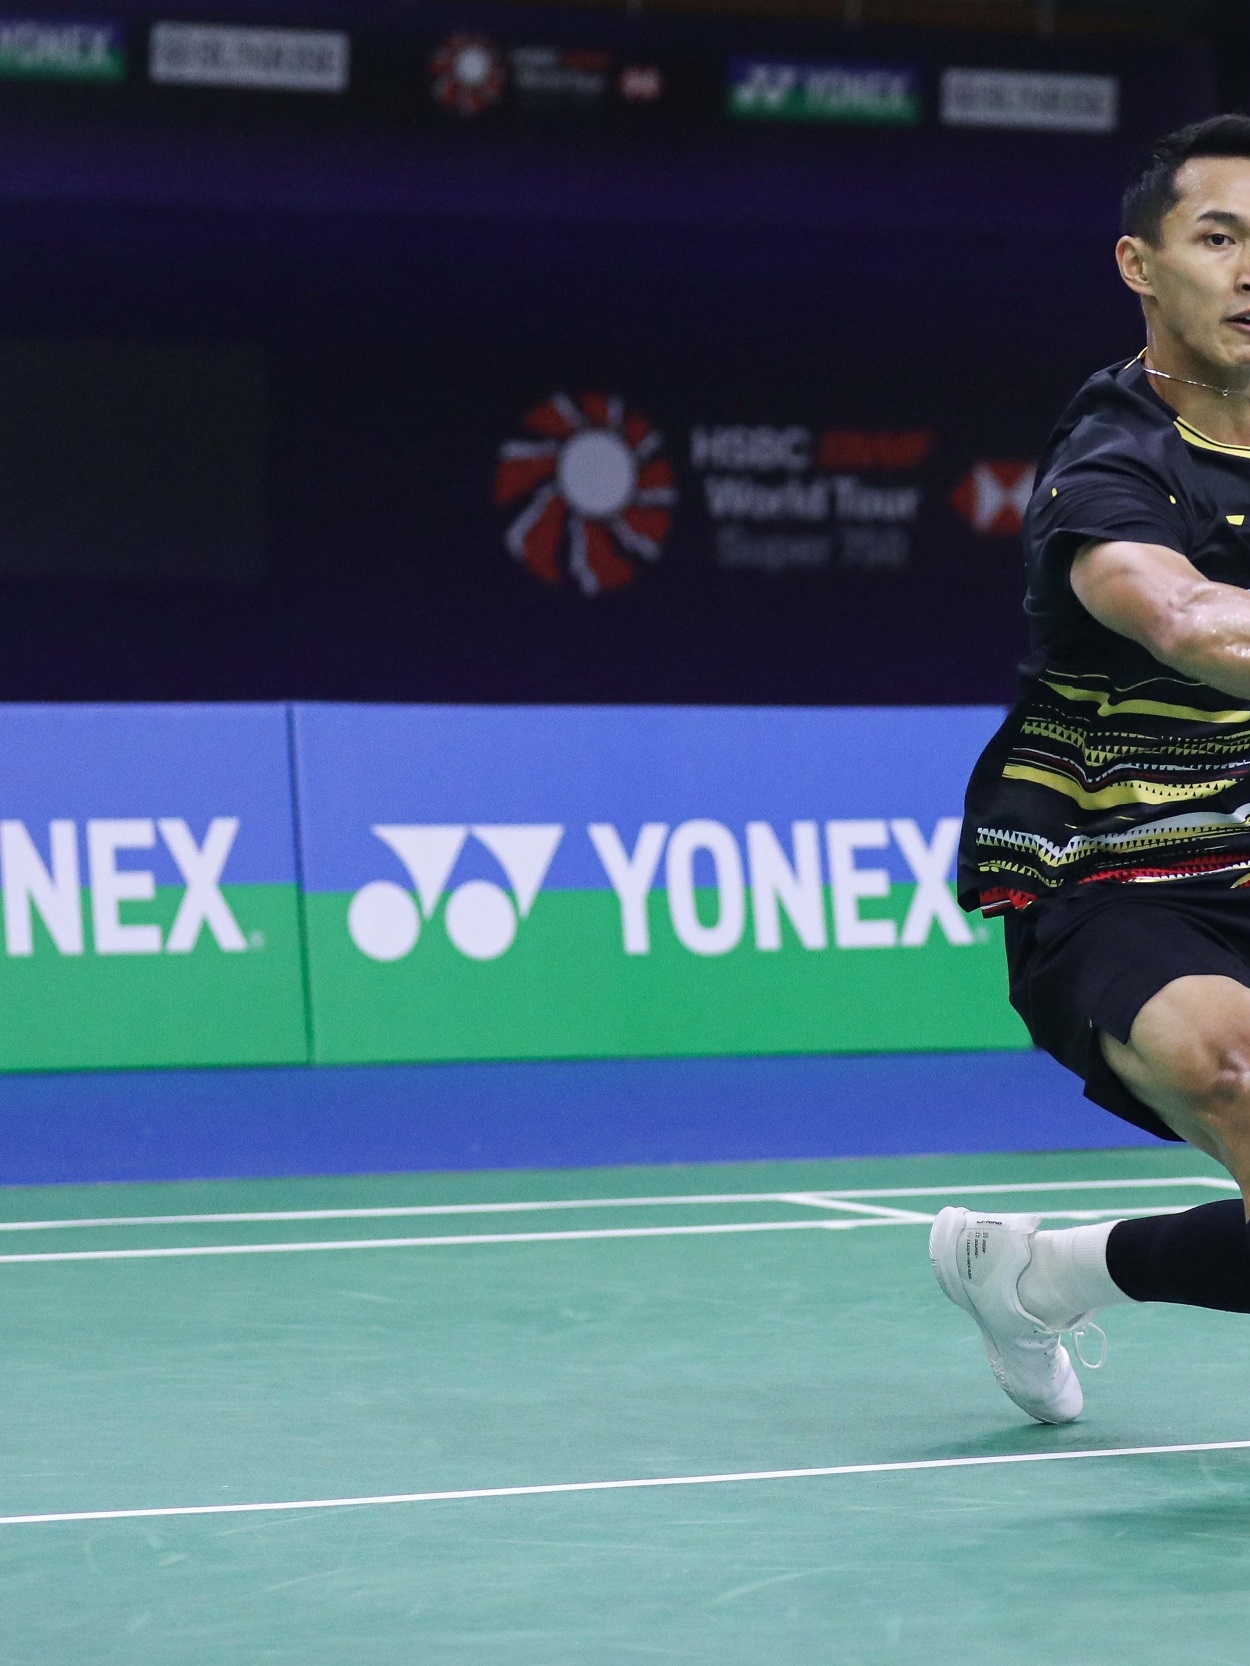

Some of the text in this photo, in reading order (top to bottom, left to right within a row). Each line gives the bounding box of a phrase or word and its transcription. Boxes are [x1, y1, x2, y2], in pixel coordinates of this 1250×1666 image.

[691, 426, 811, 468] HSBC
[704, 475, 919, 520] World Tour
[588, 817, 975, 956] YONEX
